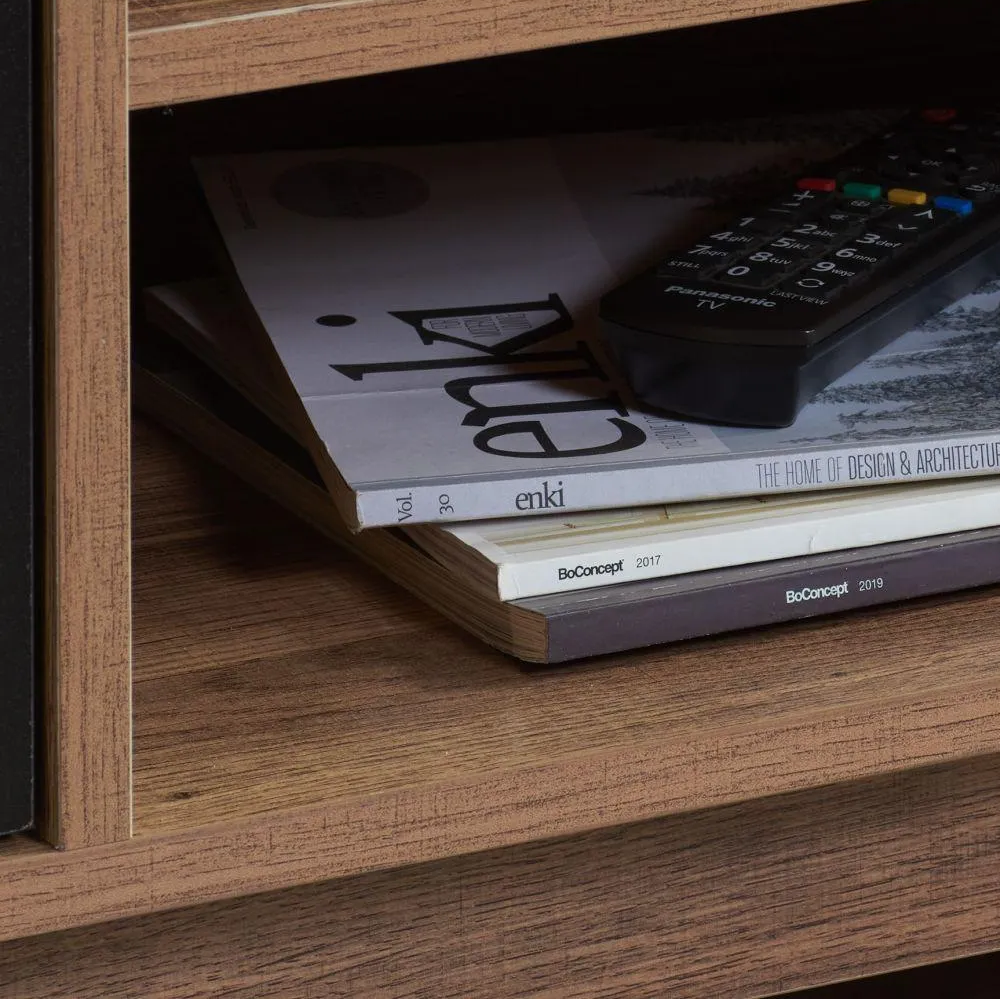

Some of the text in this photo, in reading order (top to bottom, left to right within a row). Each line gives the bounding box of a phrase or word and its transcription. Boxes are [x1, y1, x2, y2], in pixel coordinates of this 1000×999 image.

[739, 217, 756, 227] 1
[727, 265, 750, 276] 0
[664, 285, 777, 307] Panasonic
[696, 299, 726, 310] TV
[316, 293, 647, 458] enki
[756, 462, 779, 488] THE
[785, 457, 822, 486] HOME
[827, 456, 843, 482] OF
[848, 452, 895, 480] DESIGN
[900, 450, 911, 476] &
[396, 492, 413, 522] Vol.
[438, 493, 454, 514] 30
[515, 481, 565, 511] enki
[558, 555, 661, 580] BoConcept 2017
[786, 577, 883, 603] BoConcept 2019
